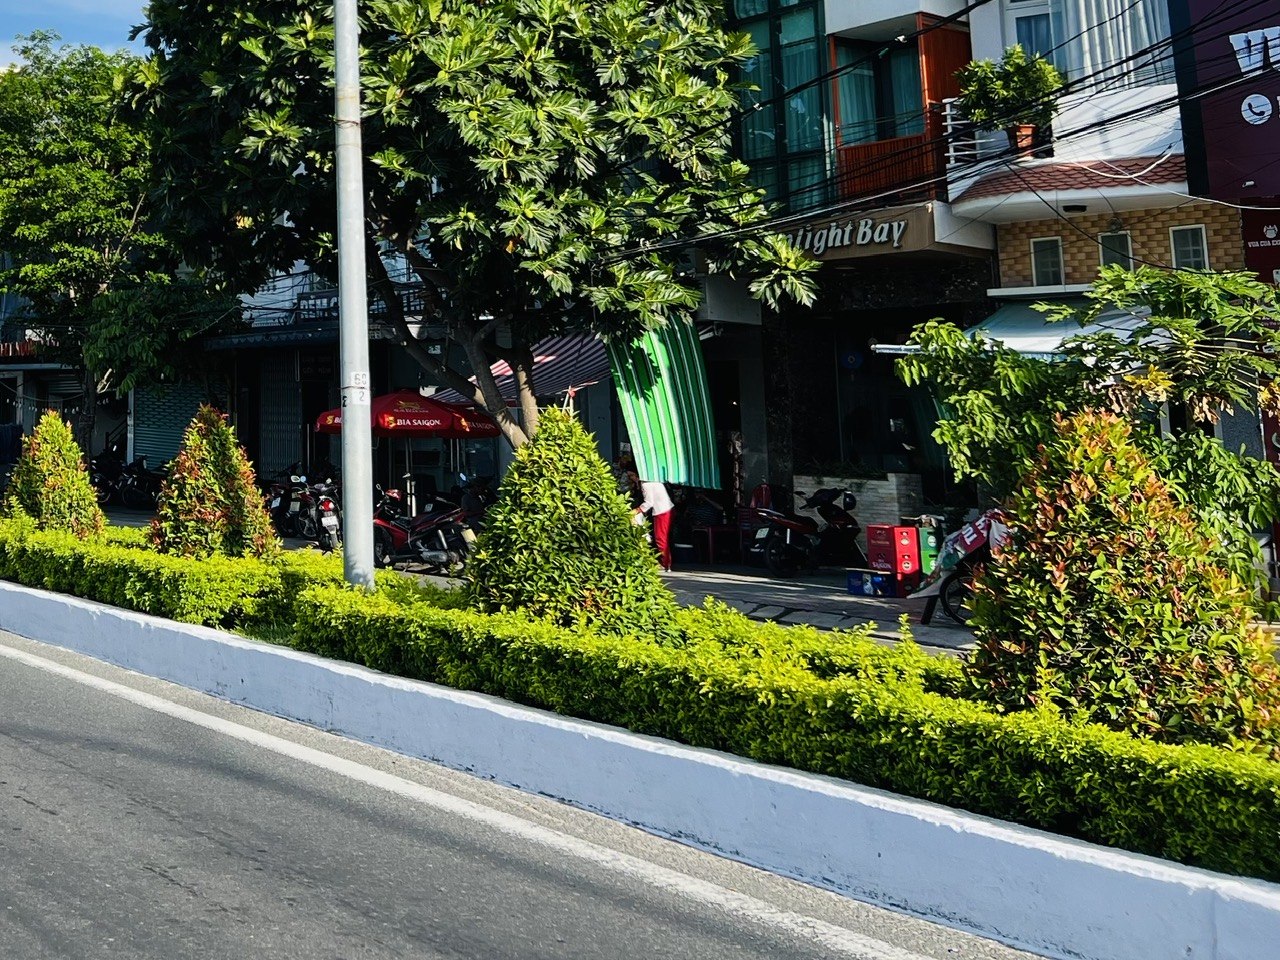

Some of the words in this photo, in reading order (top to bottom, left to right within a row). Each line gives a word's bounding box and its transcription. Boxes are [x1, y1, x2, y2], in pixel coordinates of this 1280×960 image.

[856, 218, 907, 248] Bay
[359, 390, 365, 402] 2
[397, 418, 411, 426] BIA
[412, 417, 441, 427] SAIGON
